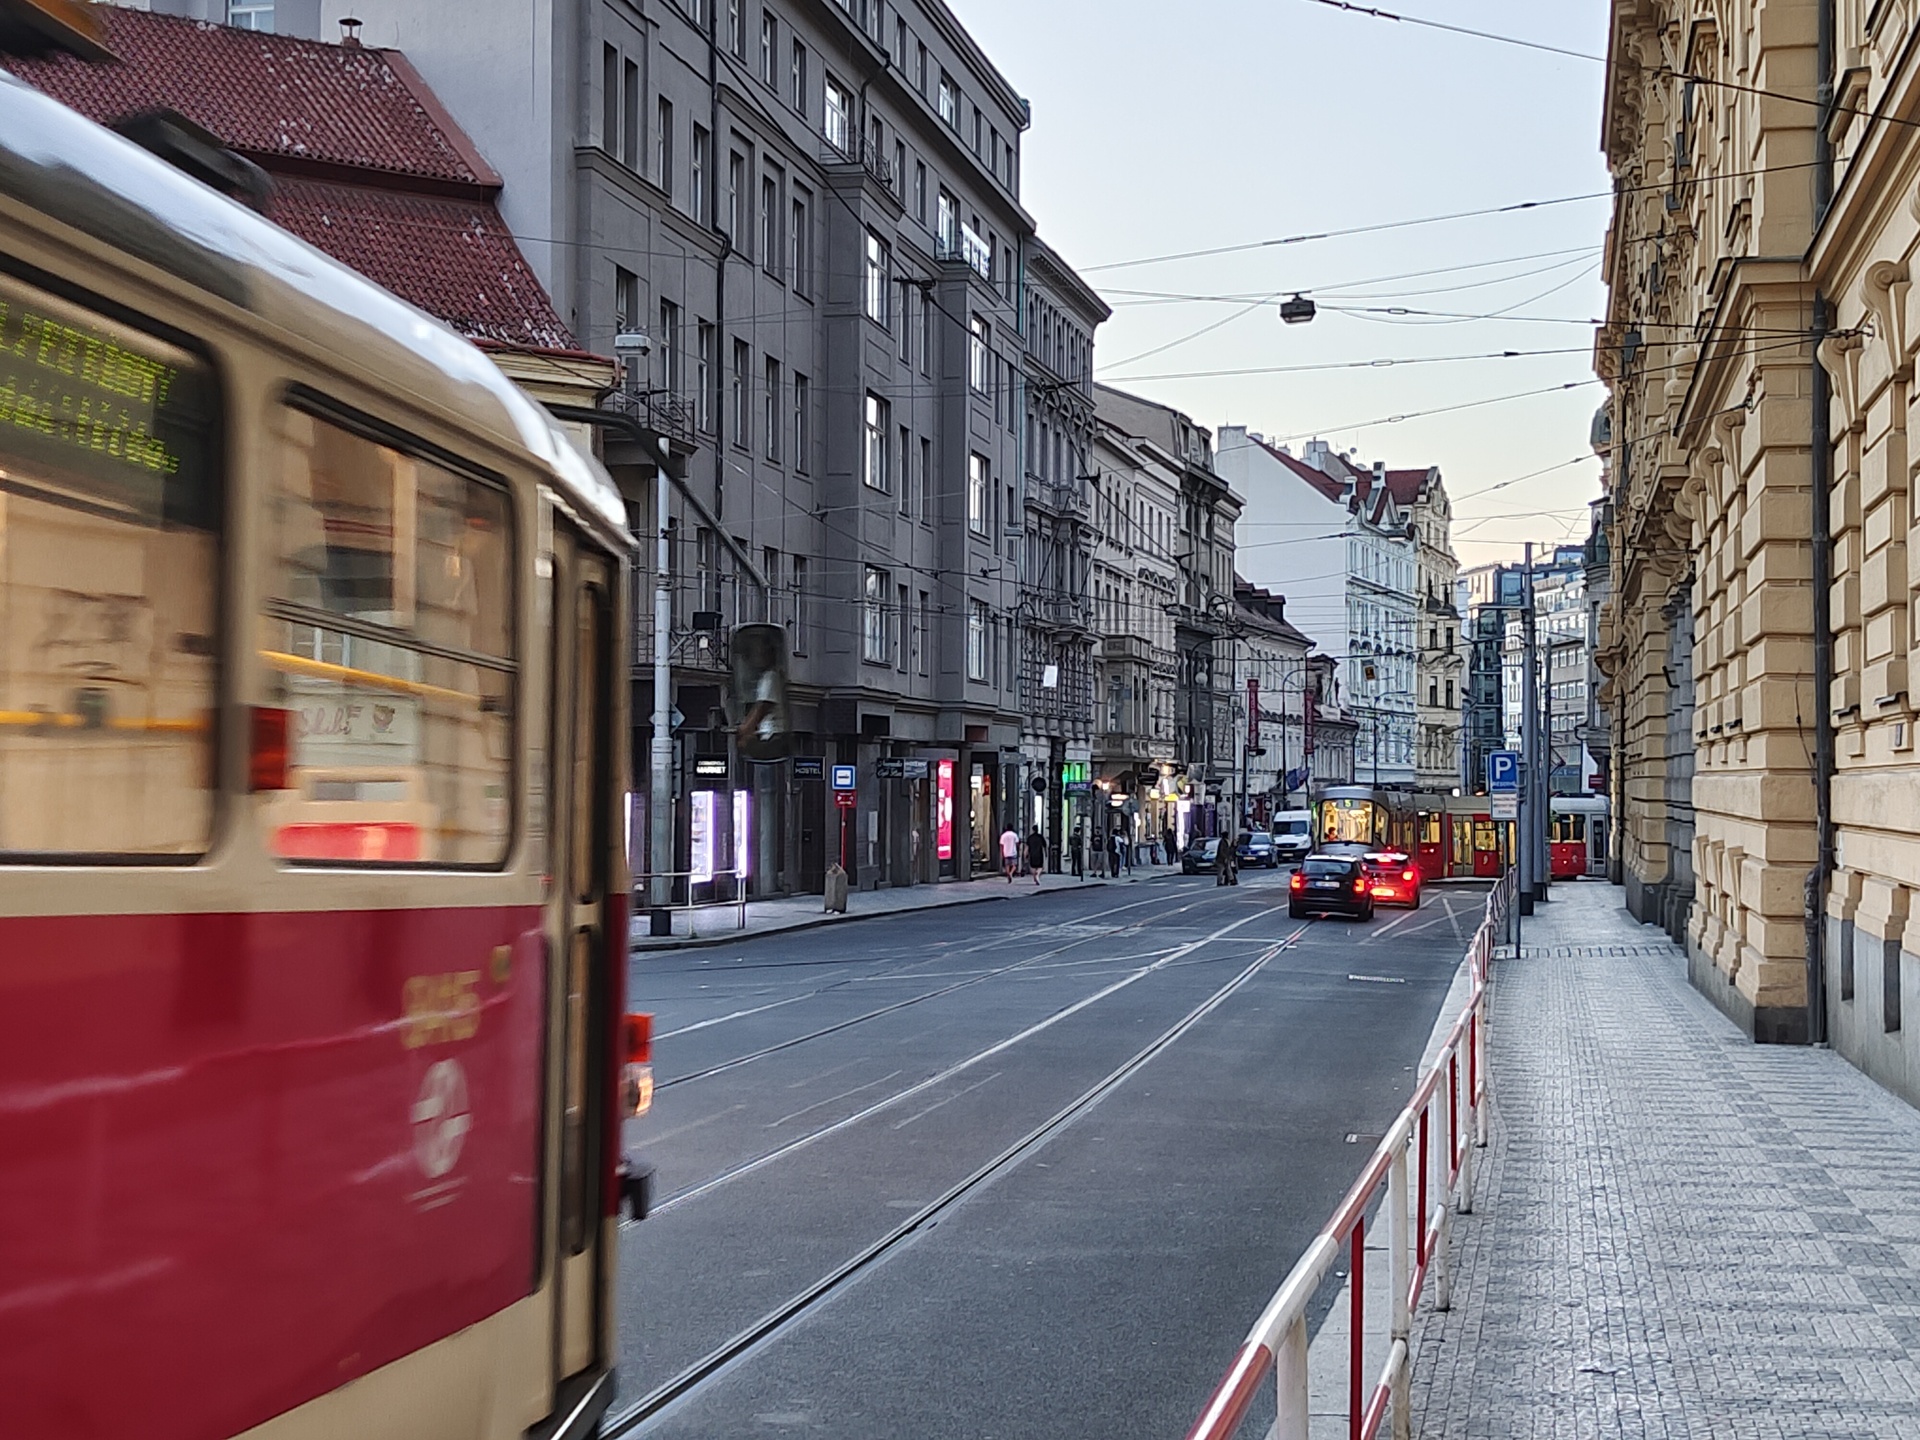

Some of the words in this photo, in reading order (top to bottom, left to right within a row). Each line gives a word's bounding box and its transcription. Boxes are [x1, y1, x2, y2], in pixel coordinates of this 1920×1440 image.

[696, 766, 727, 774] MARKET
[795, 767, 822, 775] HOSTEL
[1495, 757, 1512, 780] P
